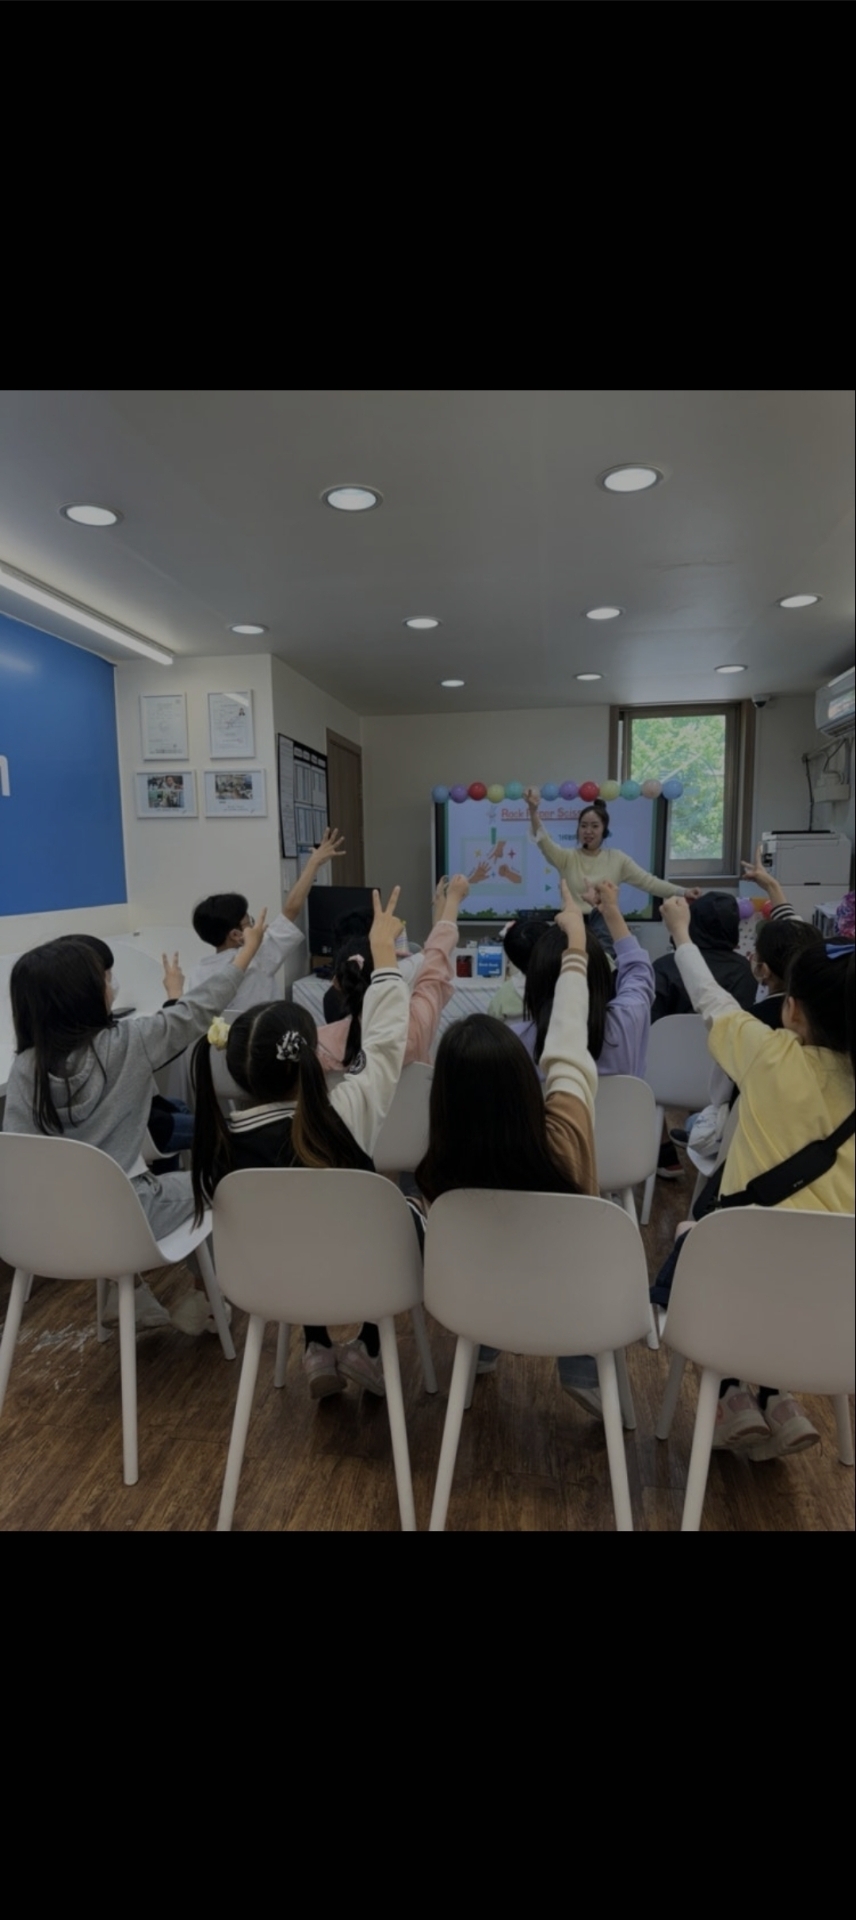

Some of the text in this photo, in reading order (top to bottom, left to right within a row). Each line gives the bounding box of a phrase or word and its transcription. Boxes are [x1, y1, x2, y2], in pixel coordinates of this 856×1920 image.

[502, 807, 580, 818] Rock Pper Sciss
